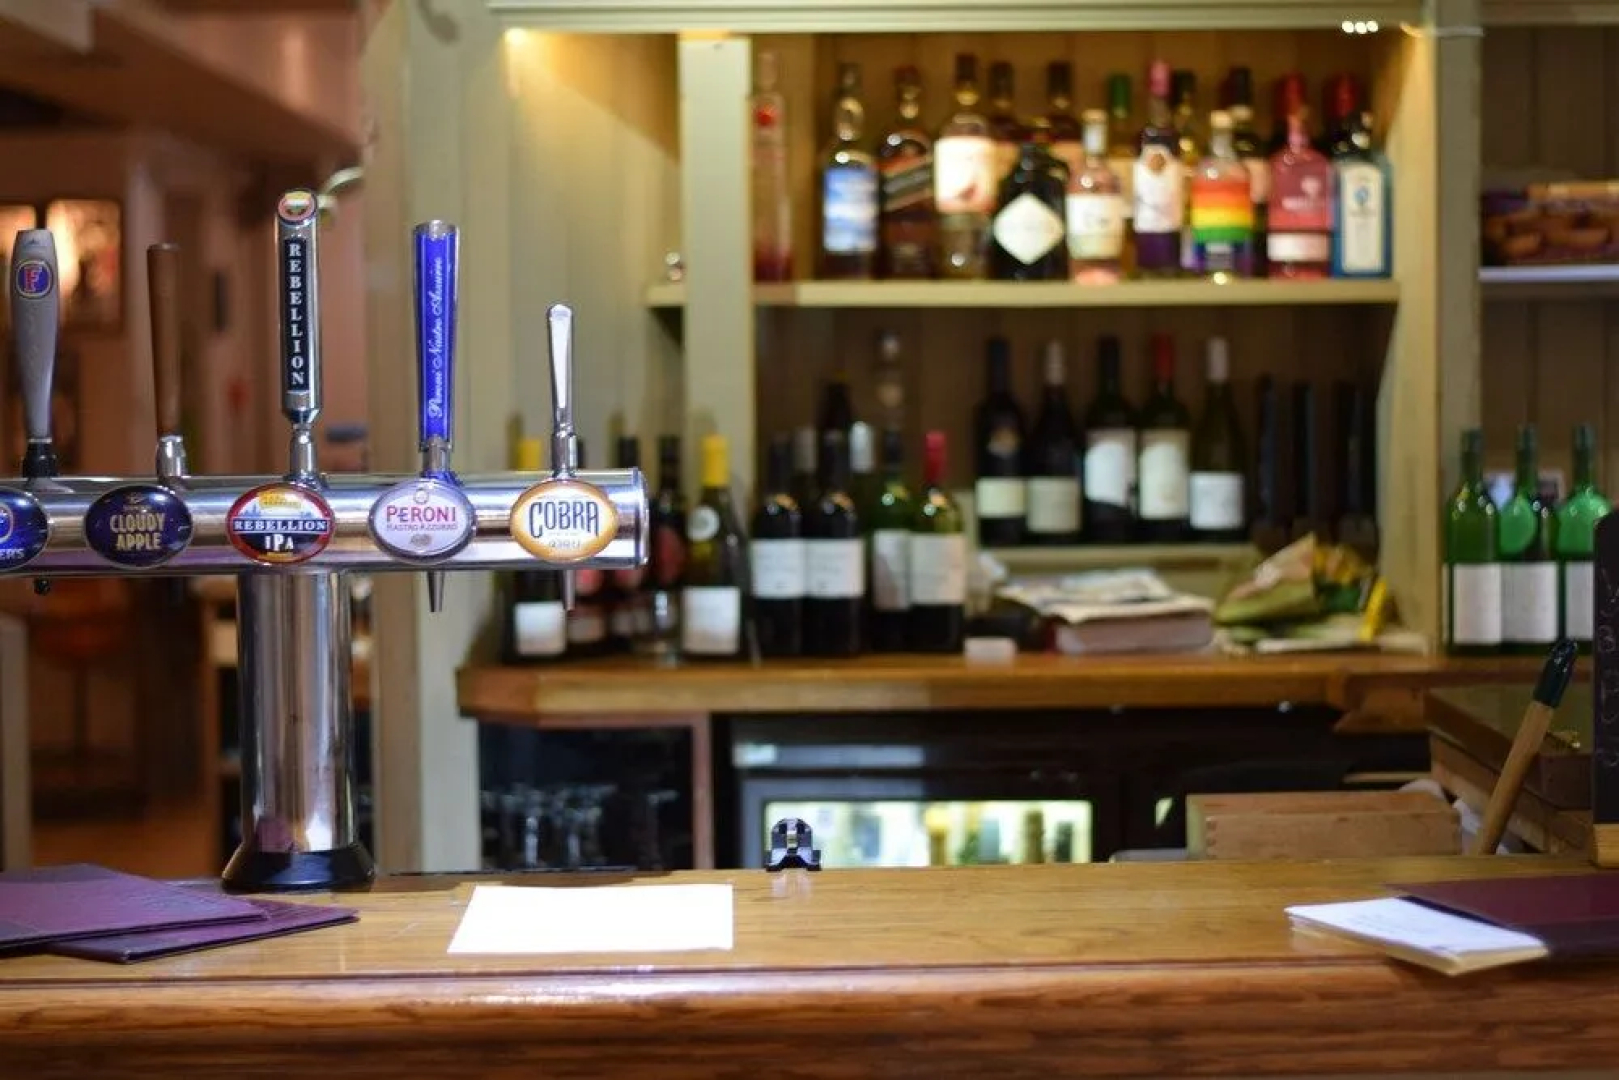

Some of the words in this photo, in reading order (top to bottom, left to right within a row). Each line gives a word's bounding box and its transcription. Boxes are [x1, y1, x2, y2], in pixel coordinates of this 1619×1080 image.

[24, 266, 43, 293] F
[288, 242, 304, 385] REBELLION
[109, 513, 166, 533] CLOUDY
[386, 505, 457, 522] PERONI
[529, 501, 599, 538] COBRA
[233, 520, 327, 531] REBELLION
[116, 532, 162, 550] APPLE
[264, 534, 294, 551] IPA
